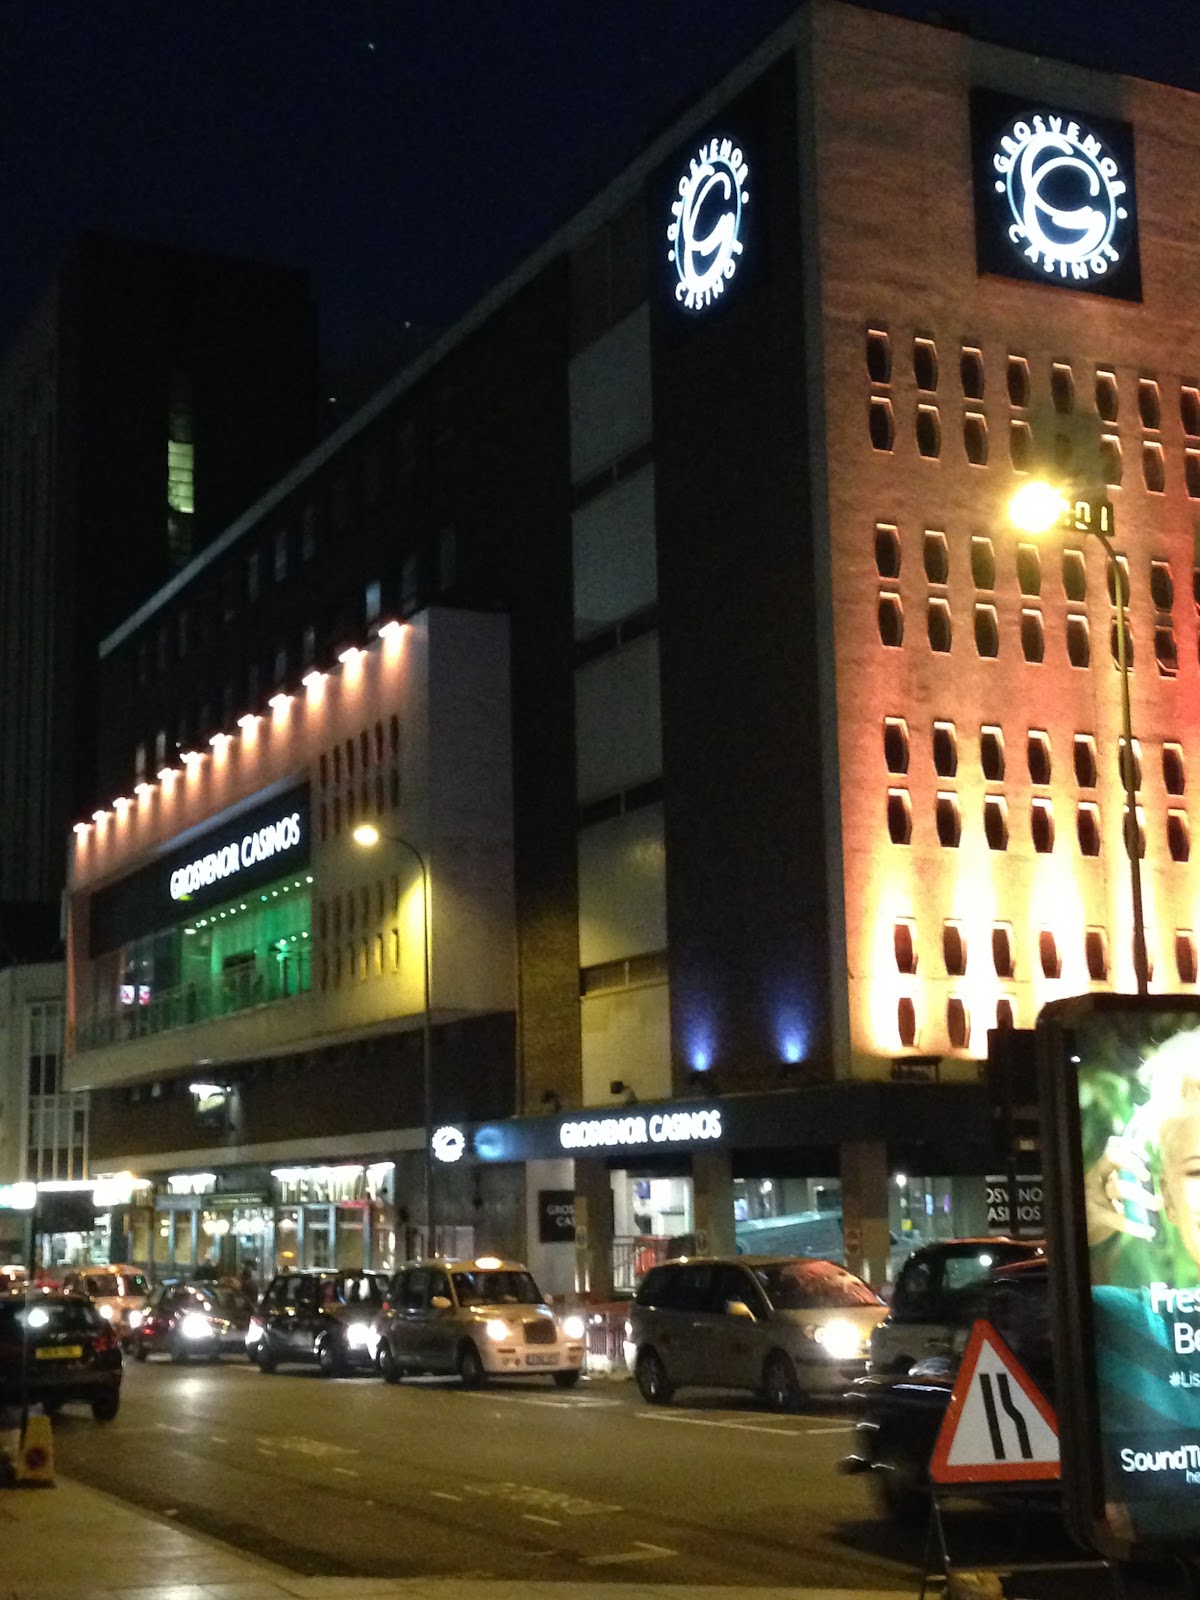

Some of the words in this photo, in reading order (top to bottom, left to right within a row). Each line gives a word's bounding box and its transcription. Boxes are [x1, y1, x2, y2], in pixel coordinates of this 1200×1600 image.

[667, 138, 748, 241] GROSVENOR
[993, 115, 1126, 198] GROSVENOR
[675, 240, 743, 310] CASINOS
[1009, 223, 1119, 279] CASINOS
[170, 843, 240, 900] GROSVENOR
[241, 813, 300, 867] CASINOS
[560, 1116, 648, 1148] GROSVENOR
[650, 1109, 721, 1142] CASINOS
